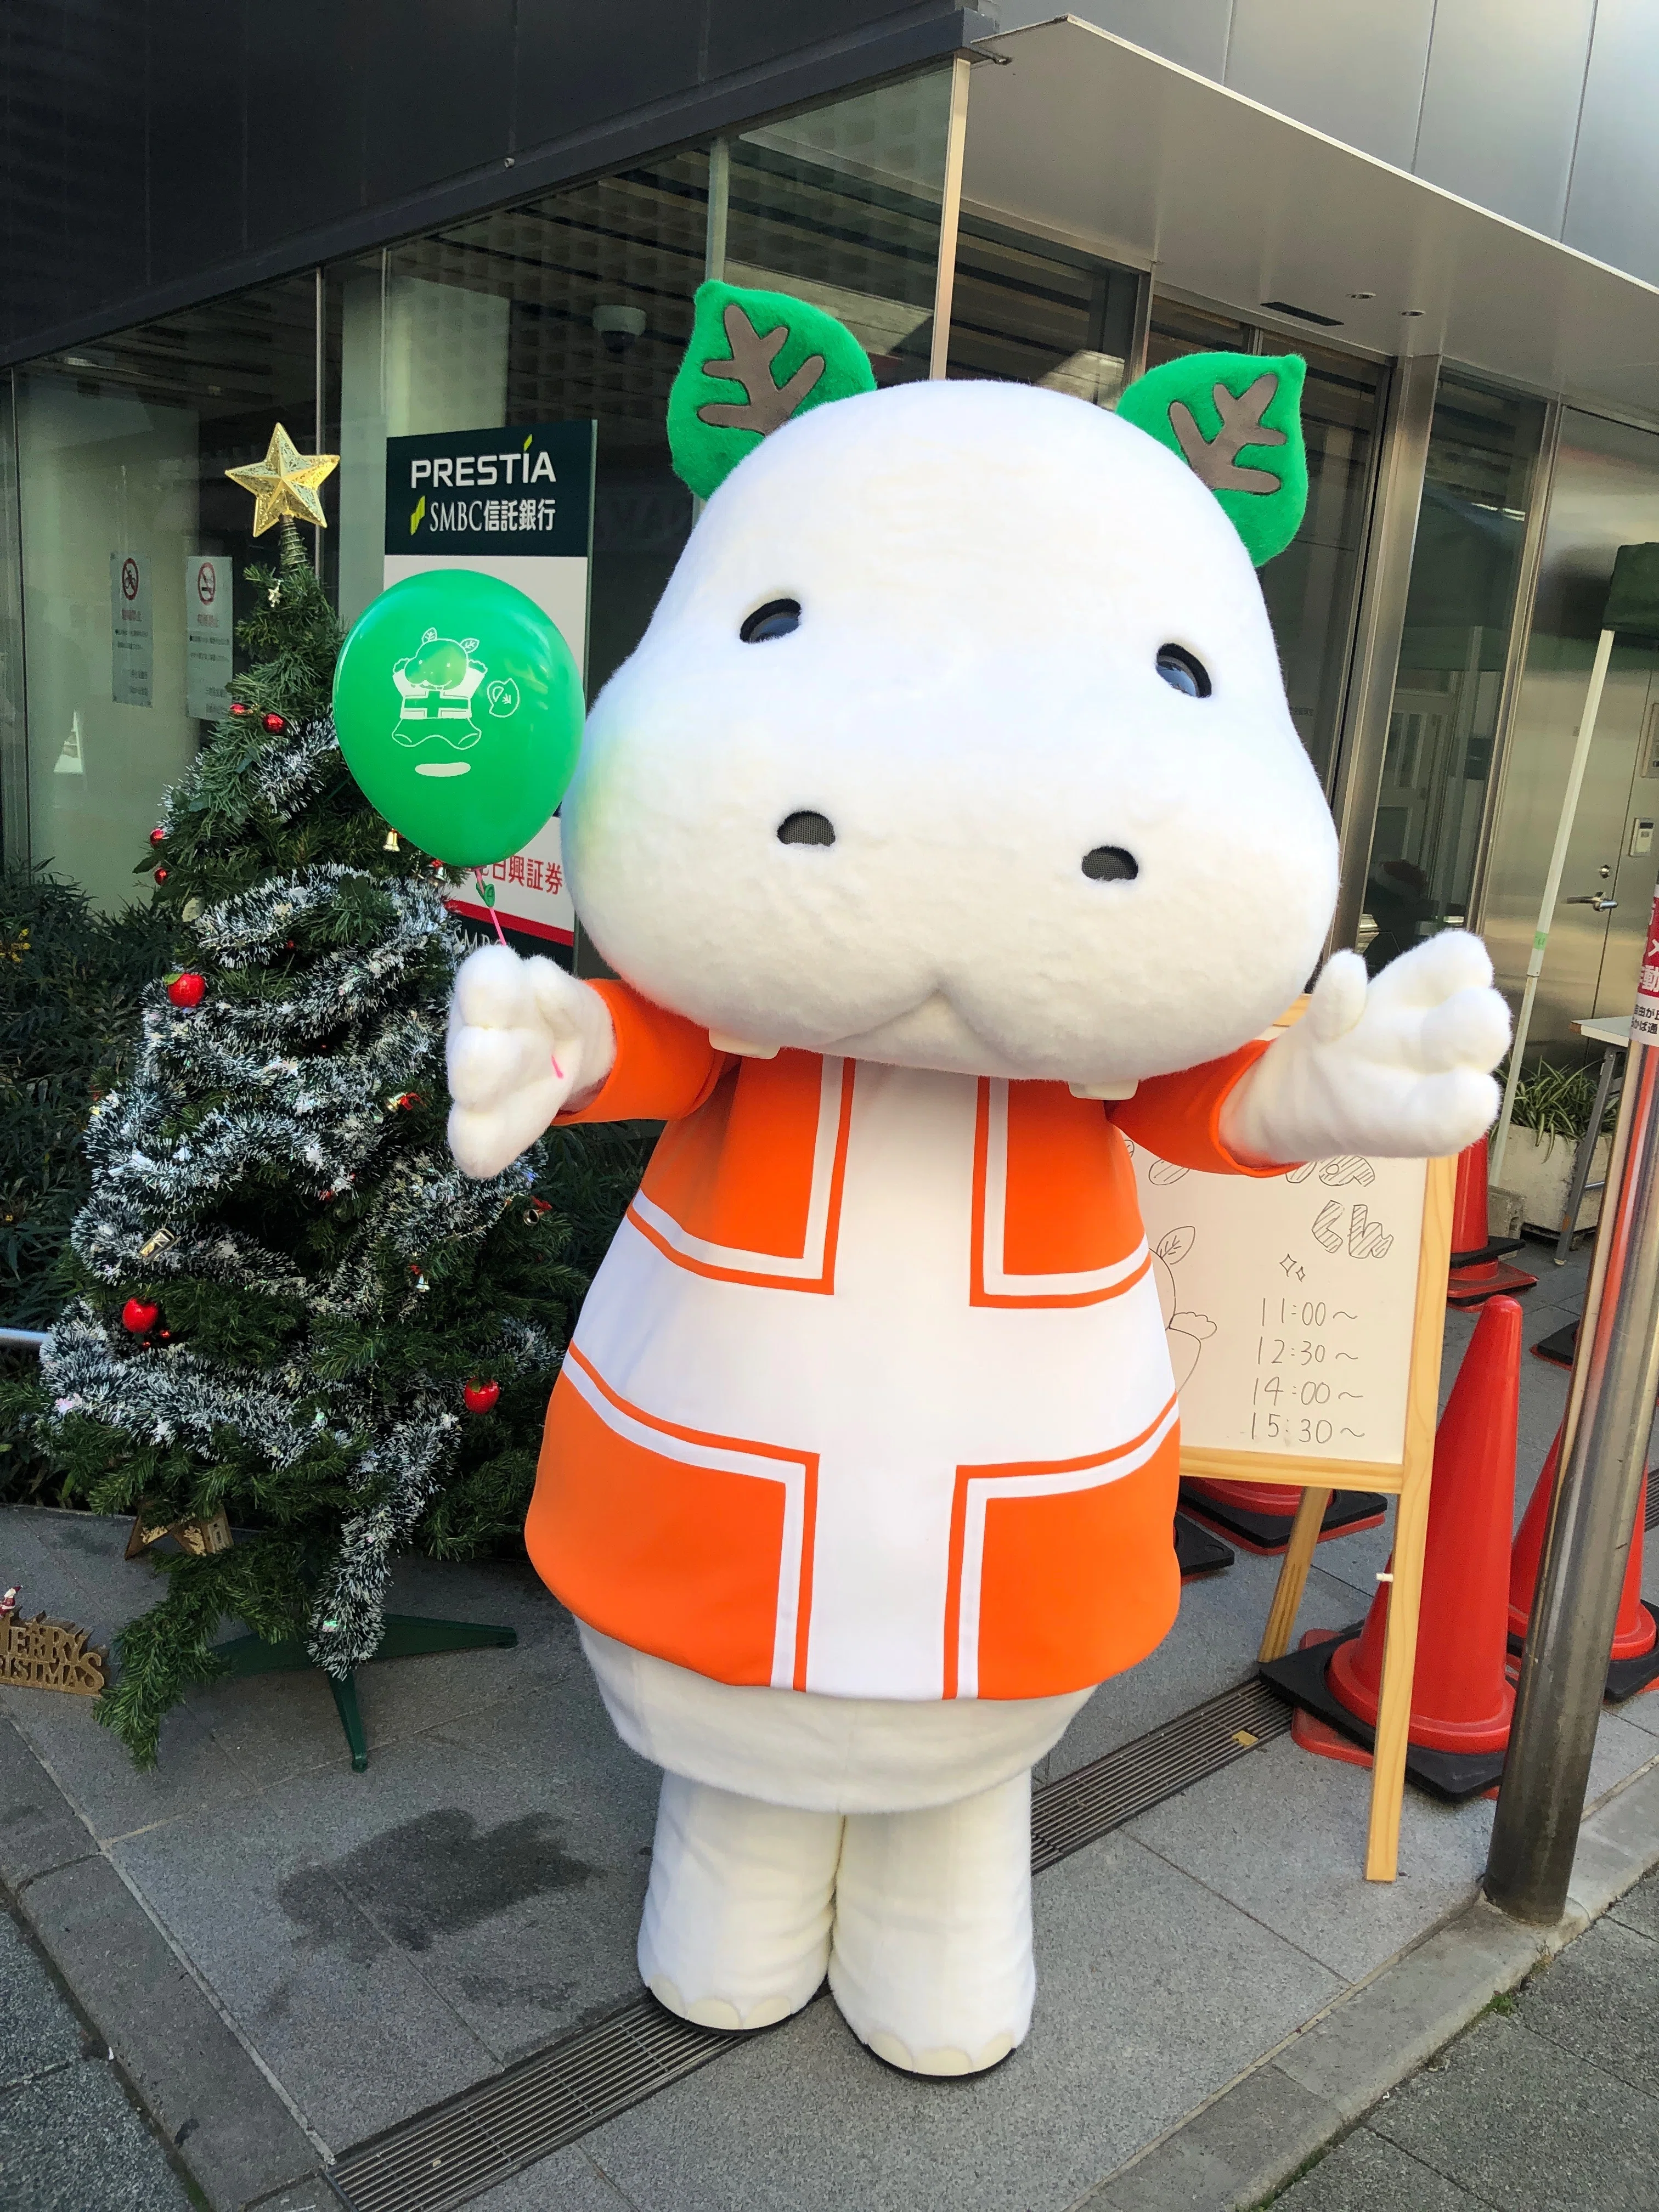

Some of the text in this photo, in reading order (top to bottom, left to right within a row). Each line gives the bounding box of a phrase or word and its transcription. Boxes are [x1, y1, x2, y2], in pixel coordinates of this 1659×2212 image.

[410, 451, 557, 489] PRESTIA
[429, 498, 556, 532] SMBC信託銀行
[483, 855, 563, 895] 日興証券
